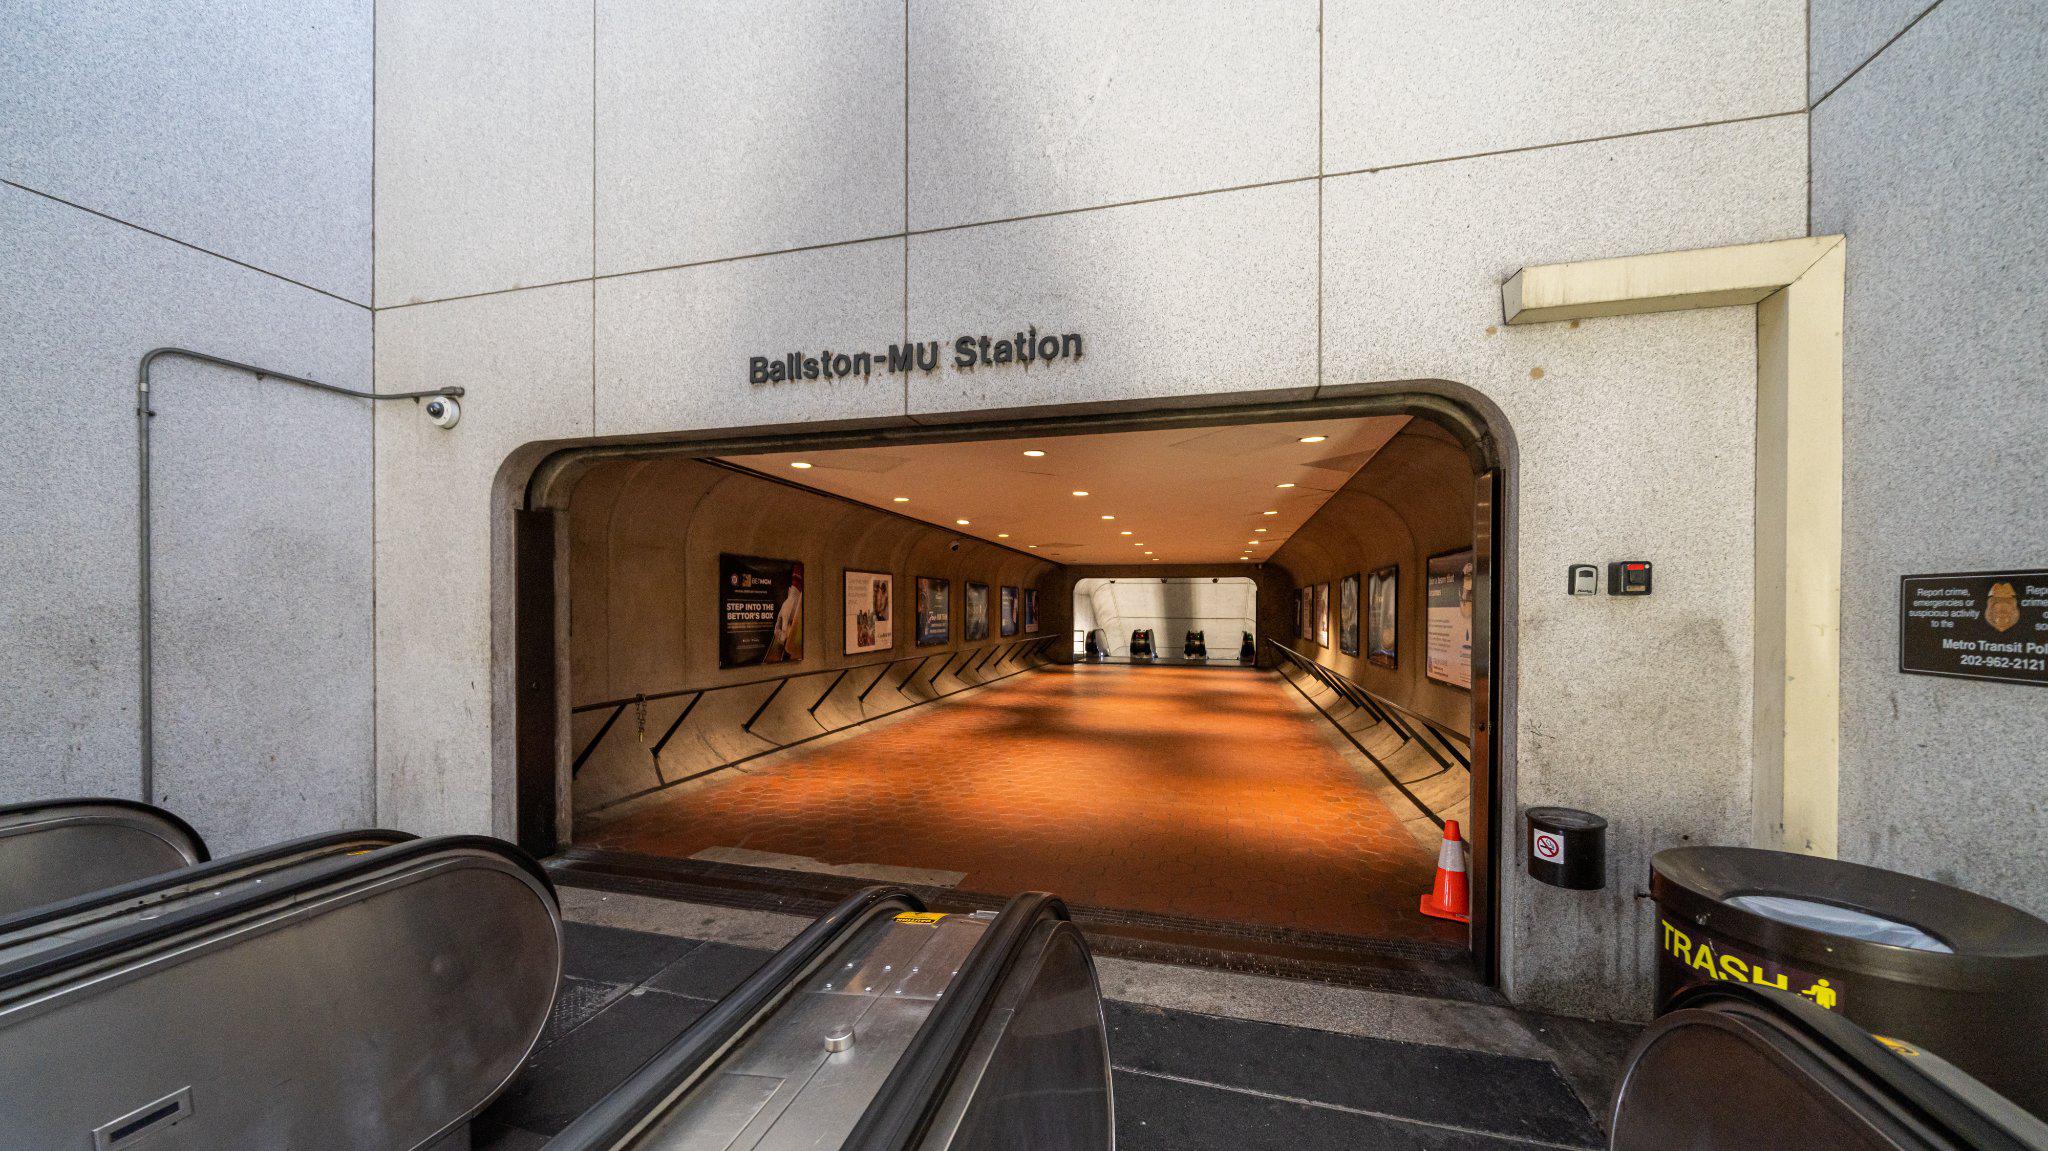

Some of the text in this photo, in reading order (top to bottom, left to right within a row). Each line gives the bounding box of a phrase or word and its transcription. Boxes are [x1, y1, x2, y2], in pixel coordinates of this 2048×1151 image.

[749, 326, 1083, 384] Ballston-MU Station
[1917, 587, 1971, 598] Report crime,
[726, 603, 774, 611] STEP INTO THE
[1913, 599, 1964, 608] emergencies
[727, 612, 774, 620] BETTOR'S BOX
[1908, 609, 1981, 620] suspicious activity
[1931, 619, 1939, 628] to
[1942, 638, 1976, 651] Metro
[1977, 640, 2023, 653] Transit
[1960, 654, 2046, 671] 202-962-2121
[1661, 919, 1789, 992] TRASH
